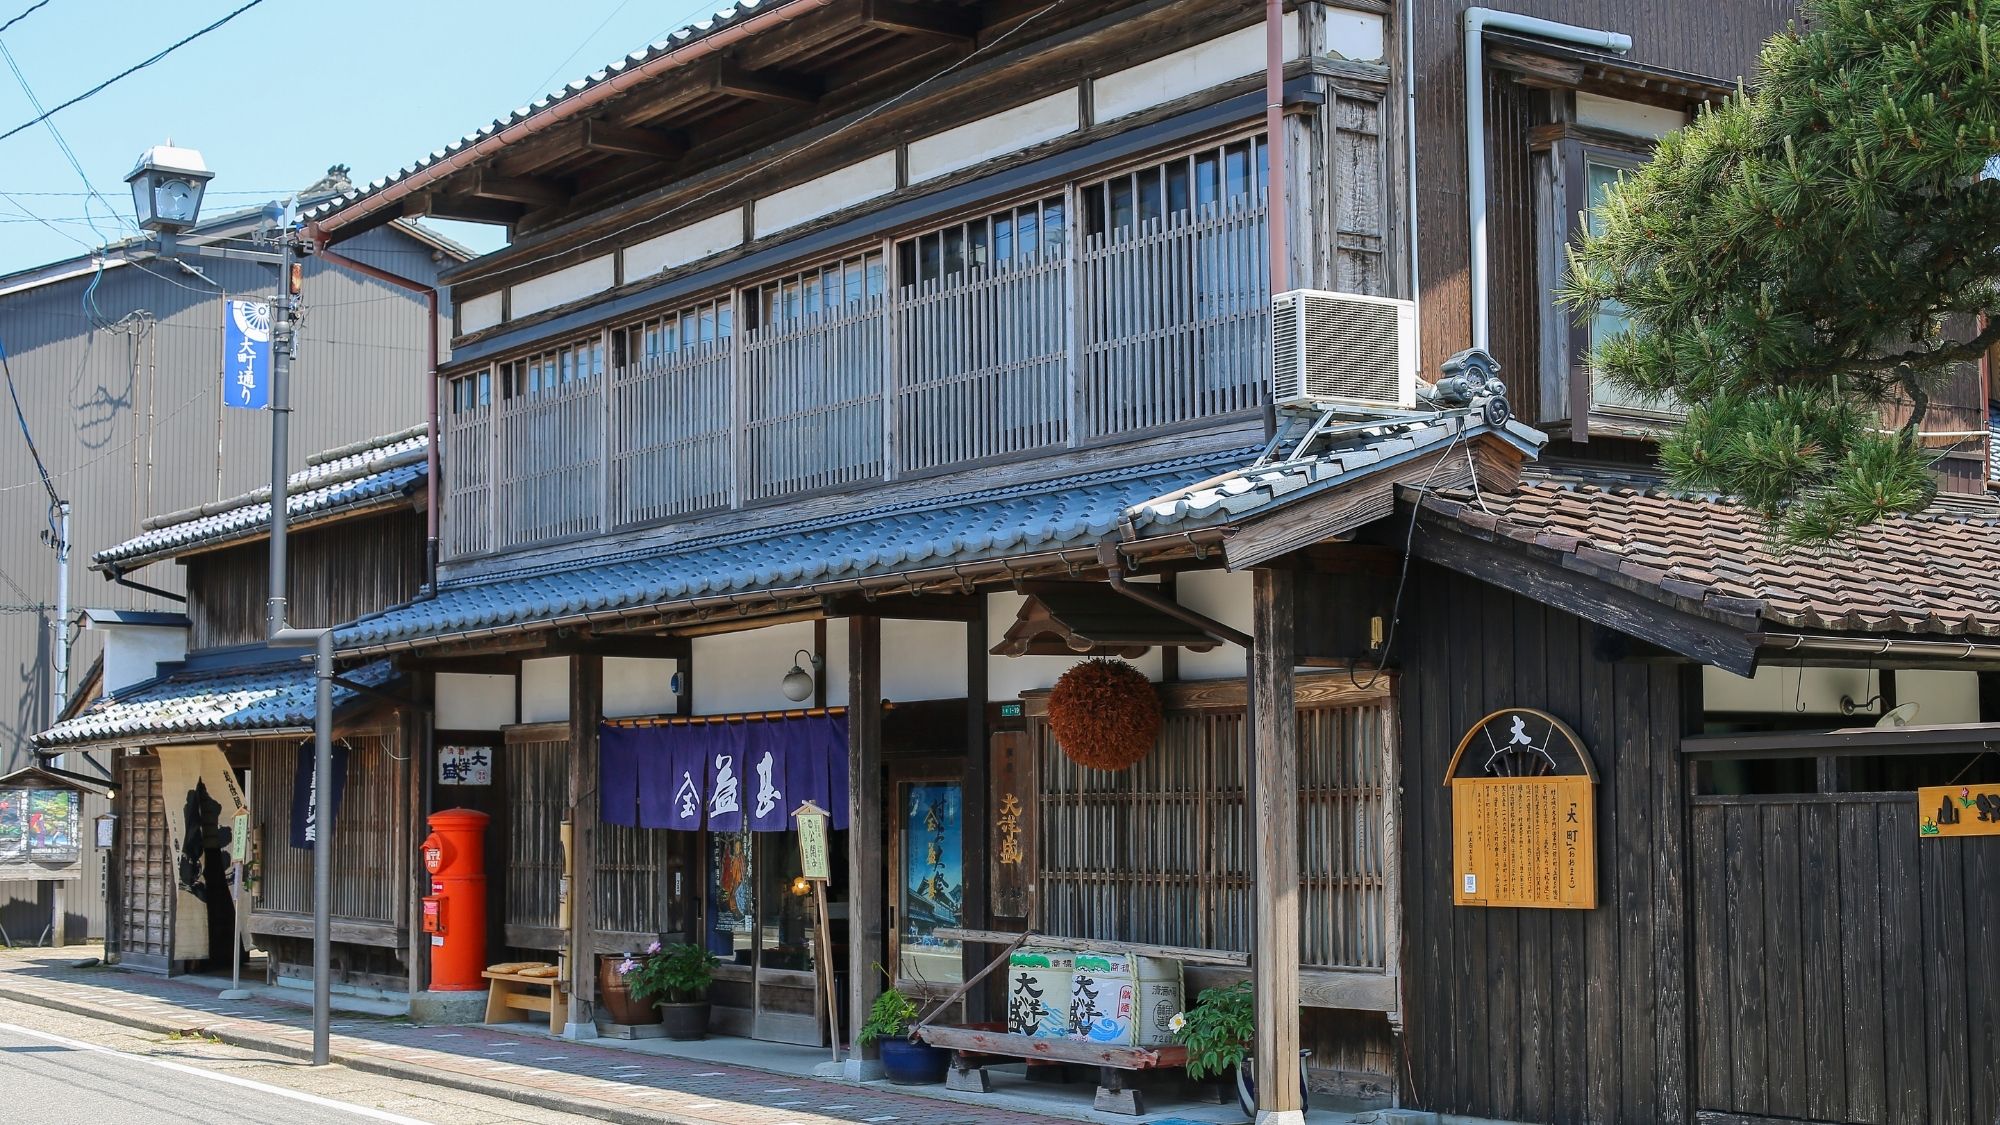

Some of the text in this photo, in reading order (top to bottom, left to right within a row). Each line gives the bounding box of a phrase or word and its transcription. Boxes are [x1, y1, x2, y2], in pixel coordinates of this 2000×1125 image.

[237, 337, 256, 405] 大町通り
[1509, 715, 1531, 745] 大
[443, 751, 488, 781] 大洋盛
[1009, 973, 1049, 1036] 大洋盛
[1067, 975, 1103, 1036] 大洋盛
